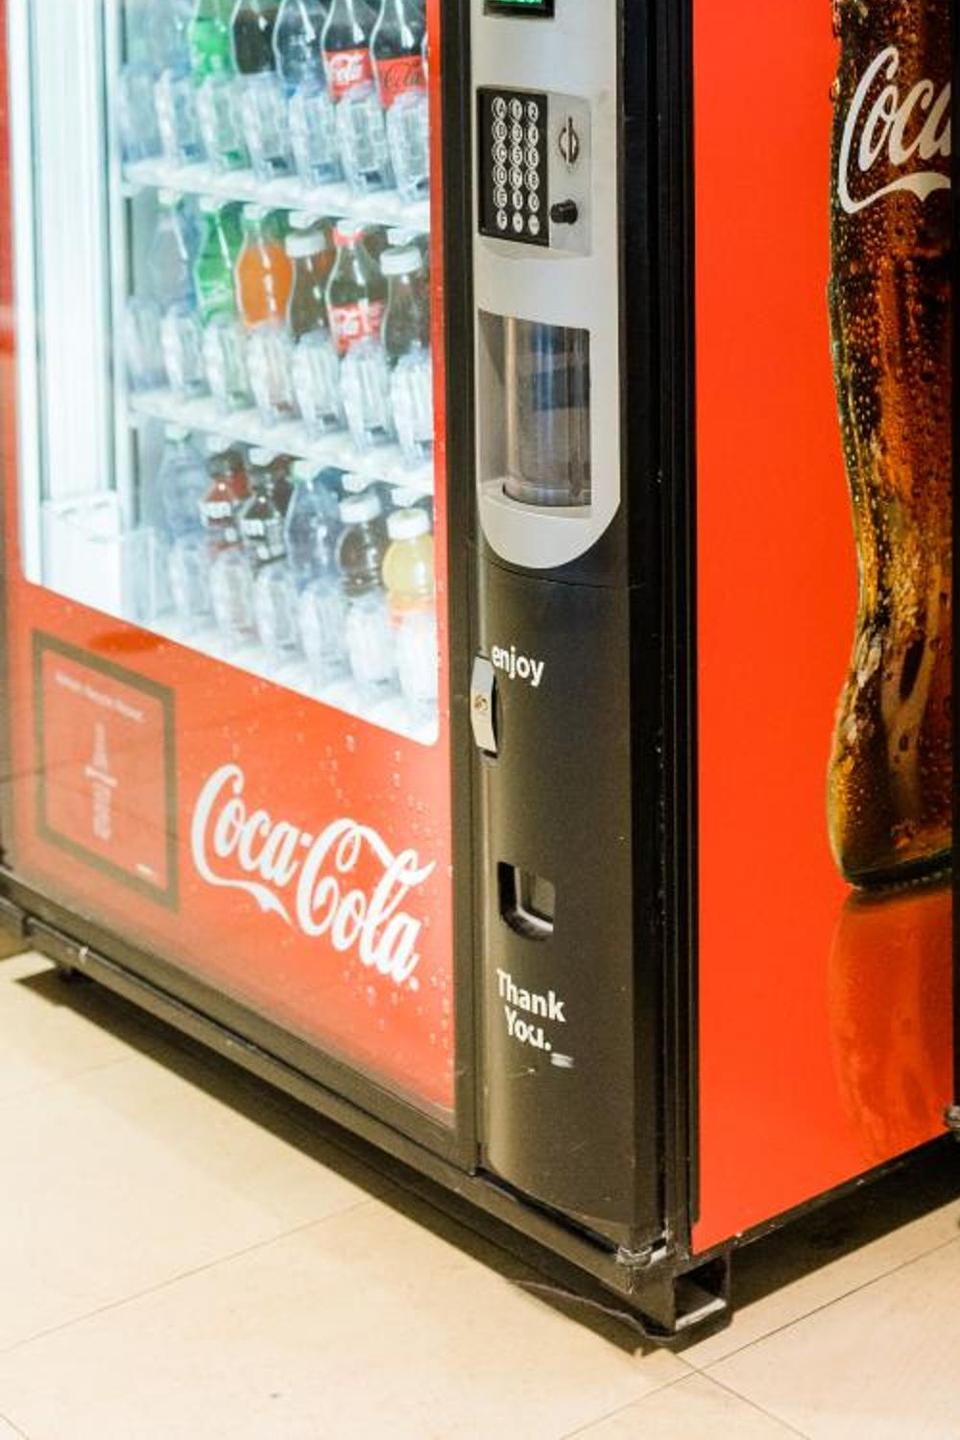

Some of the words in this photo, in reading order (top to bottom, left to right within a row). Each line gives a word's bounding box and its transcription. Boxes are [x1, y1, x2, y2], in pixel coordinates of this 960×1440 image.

[491, 644, 545, 688] enjoy
[191, 763, 437, 991] Coca-Cola
[497, 968, 566, 1024] Thank
